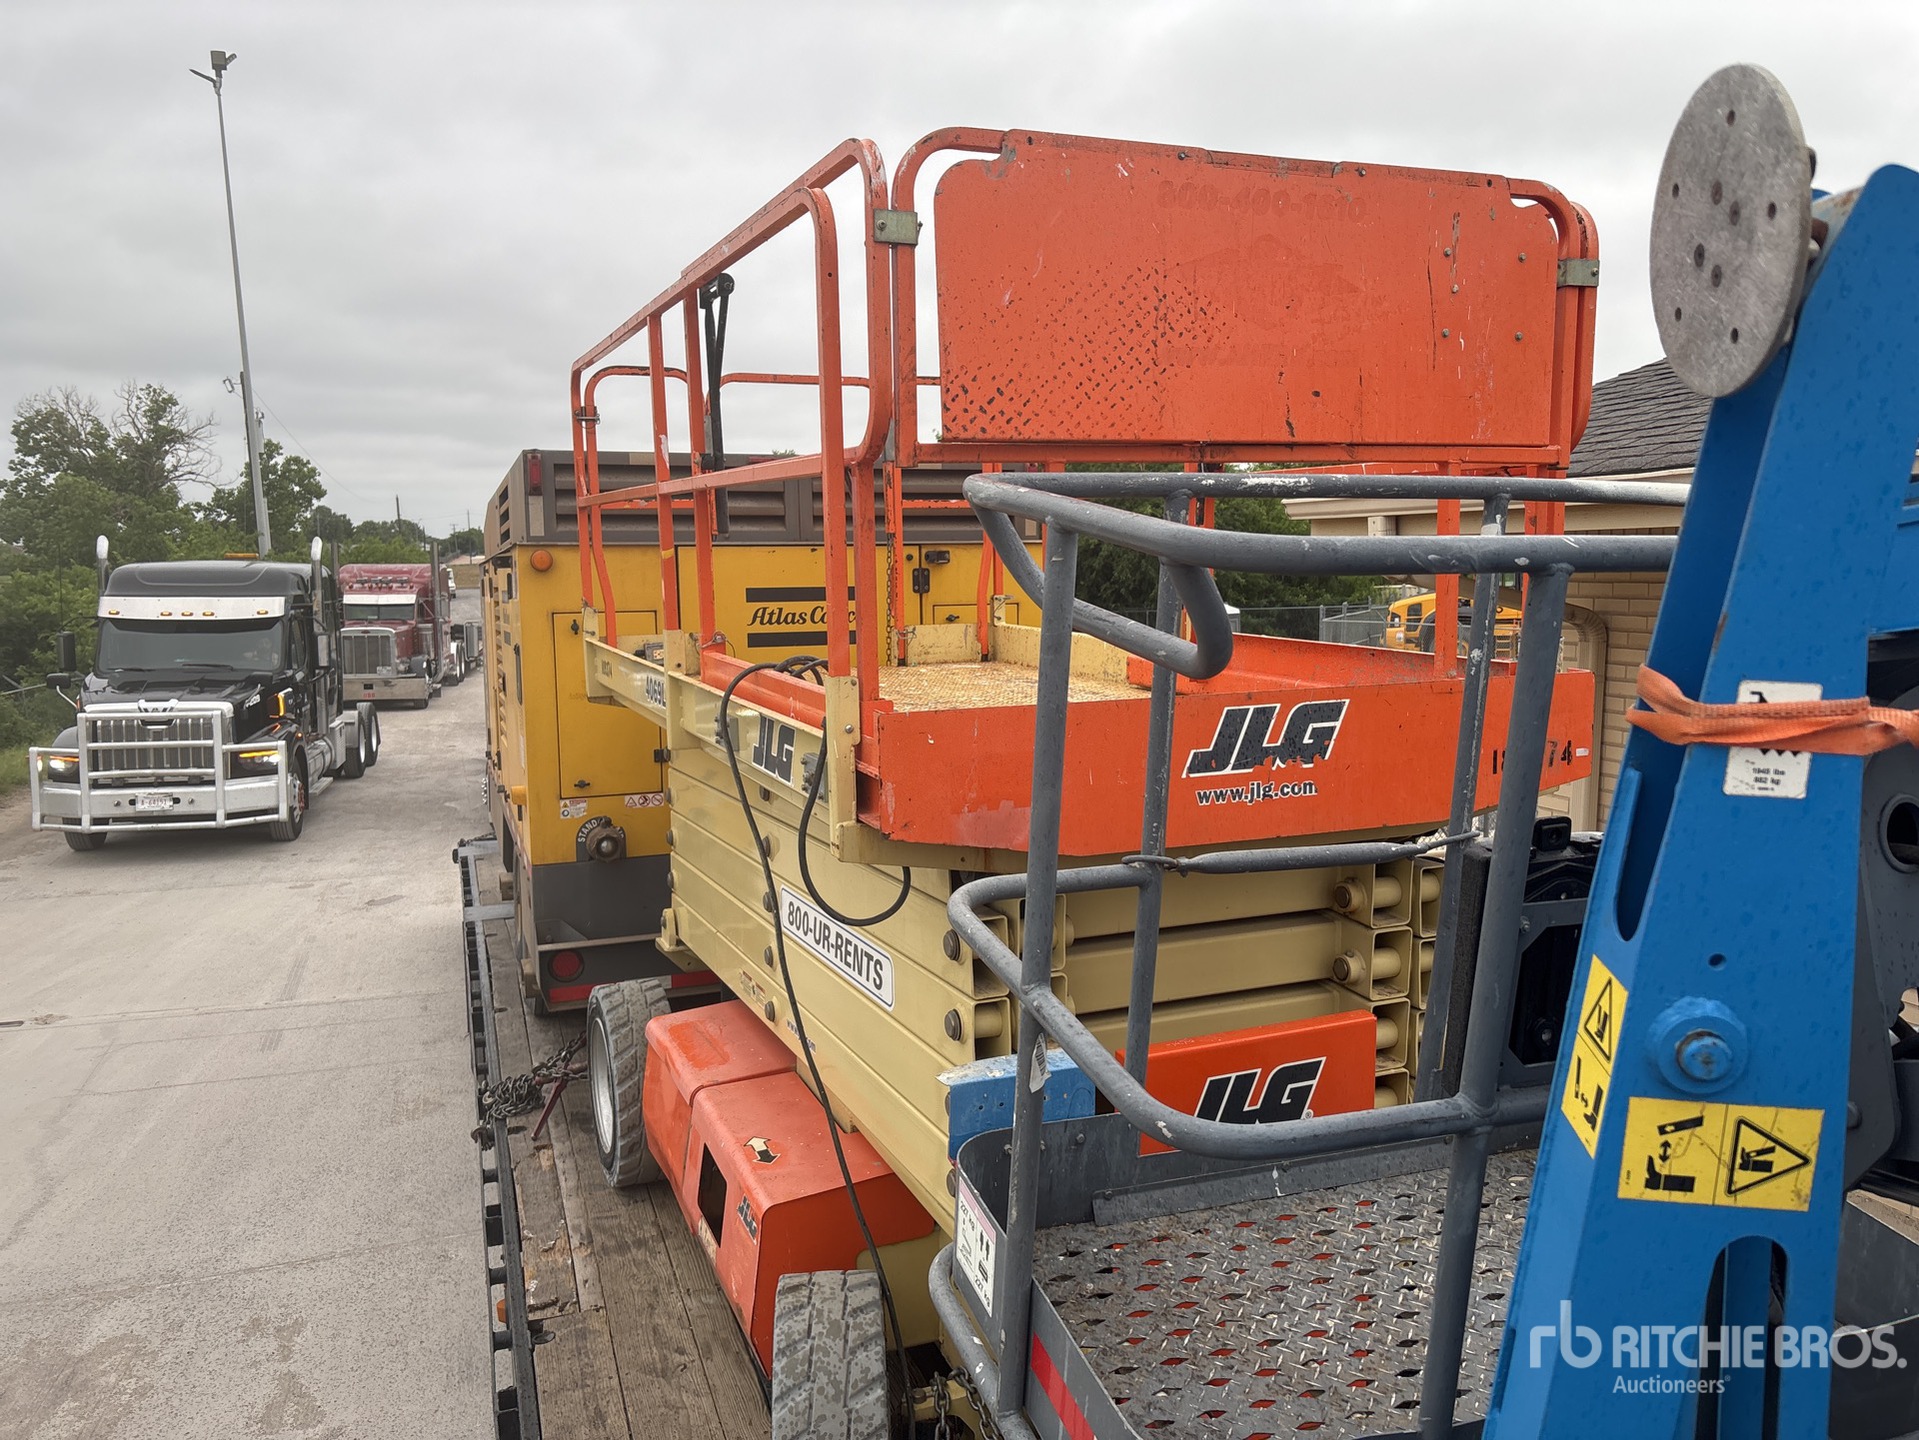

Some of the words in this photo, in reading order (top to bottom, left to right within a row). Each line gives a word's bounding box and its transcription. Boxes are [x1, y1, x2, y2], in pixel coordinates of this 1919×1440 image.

[747, 606, 807, 626] Atlas
[752, 714, 796, 787] JLG
[1181, 699, 1350, 778] JLG
[788, 901, 883, 991] 800-UR-RENTS
